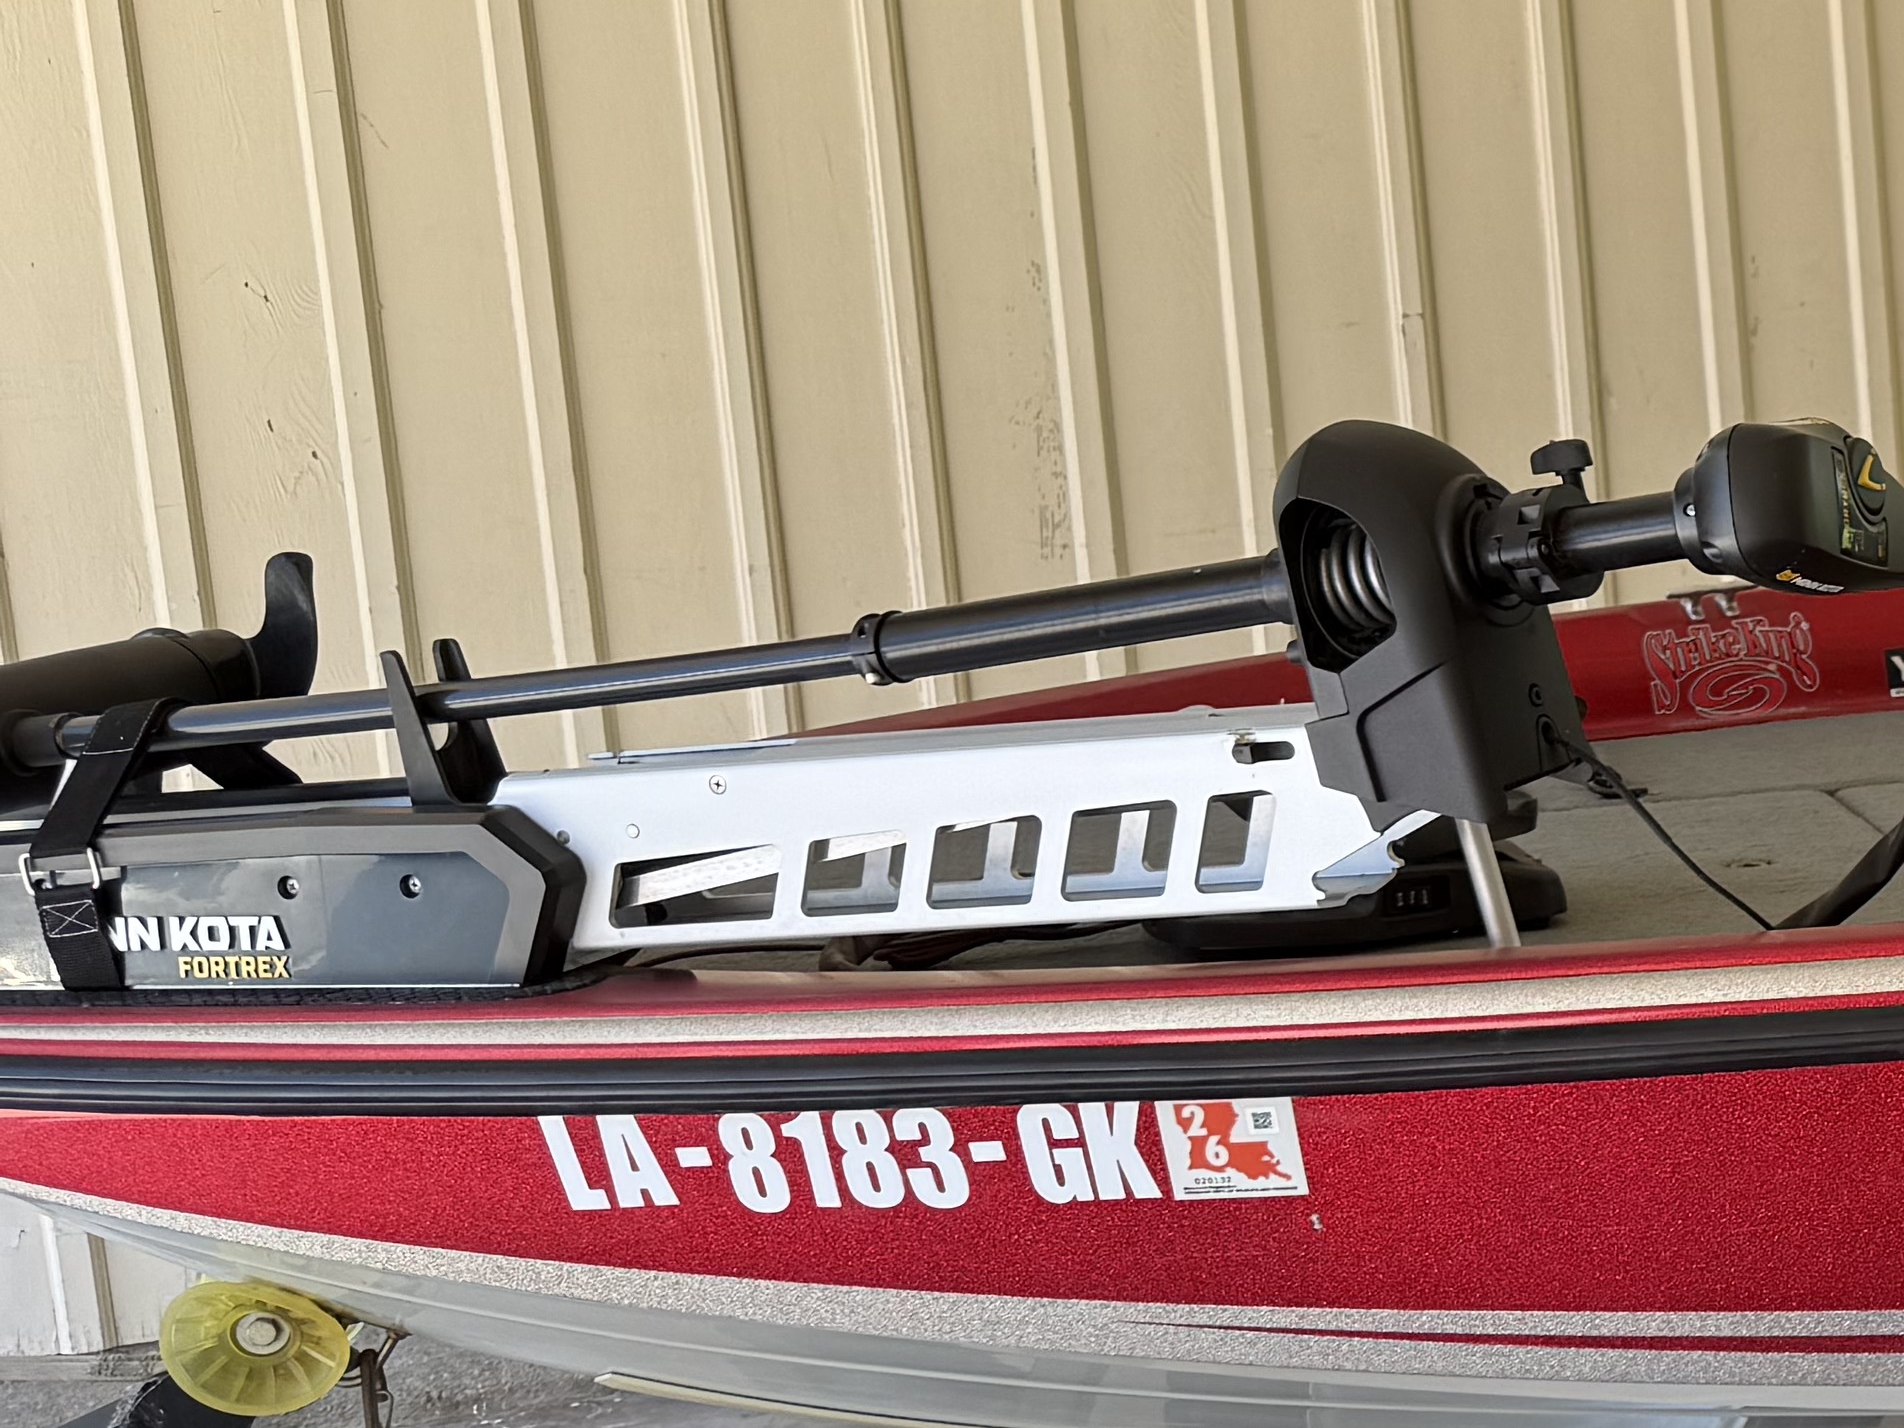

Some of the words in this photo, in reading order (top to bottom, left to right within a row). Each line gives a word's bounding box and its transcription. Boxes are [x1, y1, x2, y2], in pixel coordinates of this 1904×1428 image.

[107, 915, 161, 953] NN
[168, 915, 286, 952] KOTA
[177, 955, 290, 980] FORTREX
[536, 1100, 1164, 1214] LA-8183-GK
